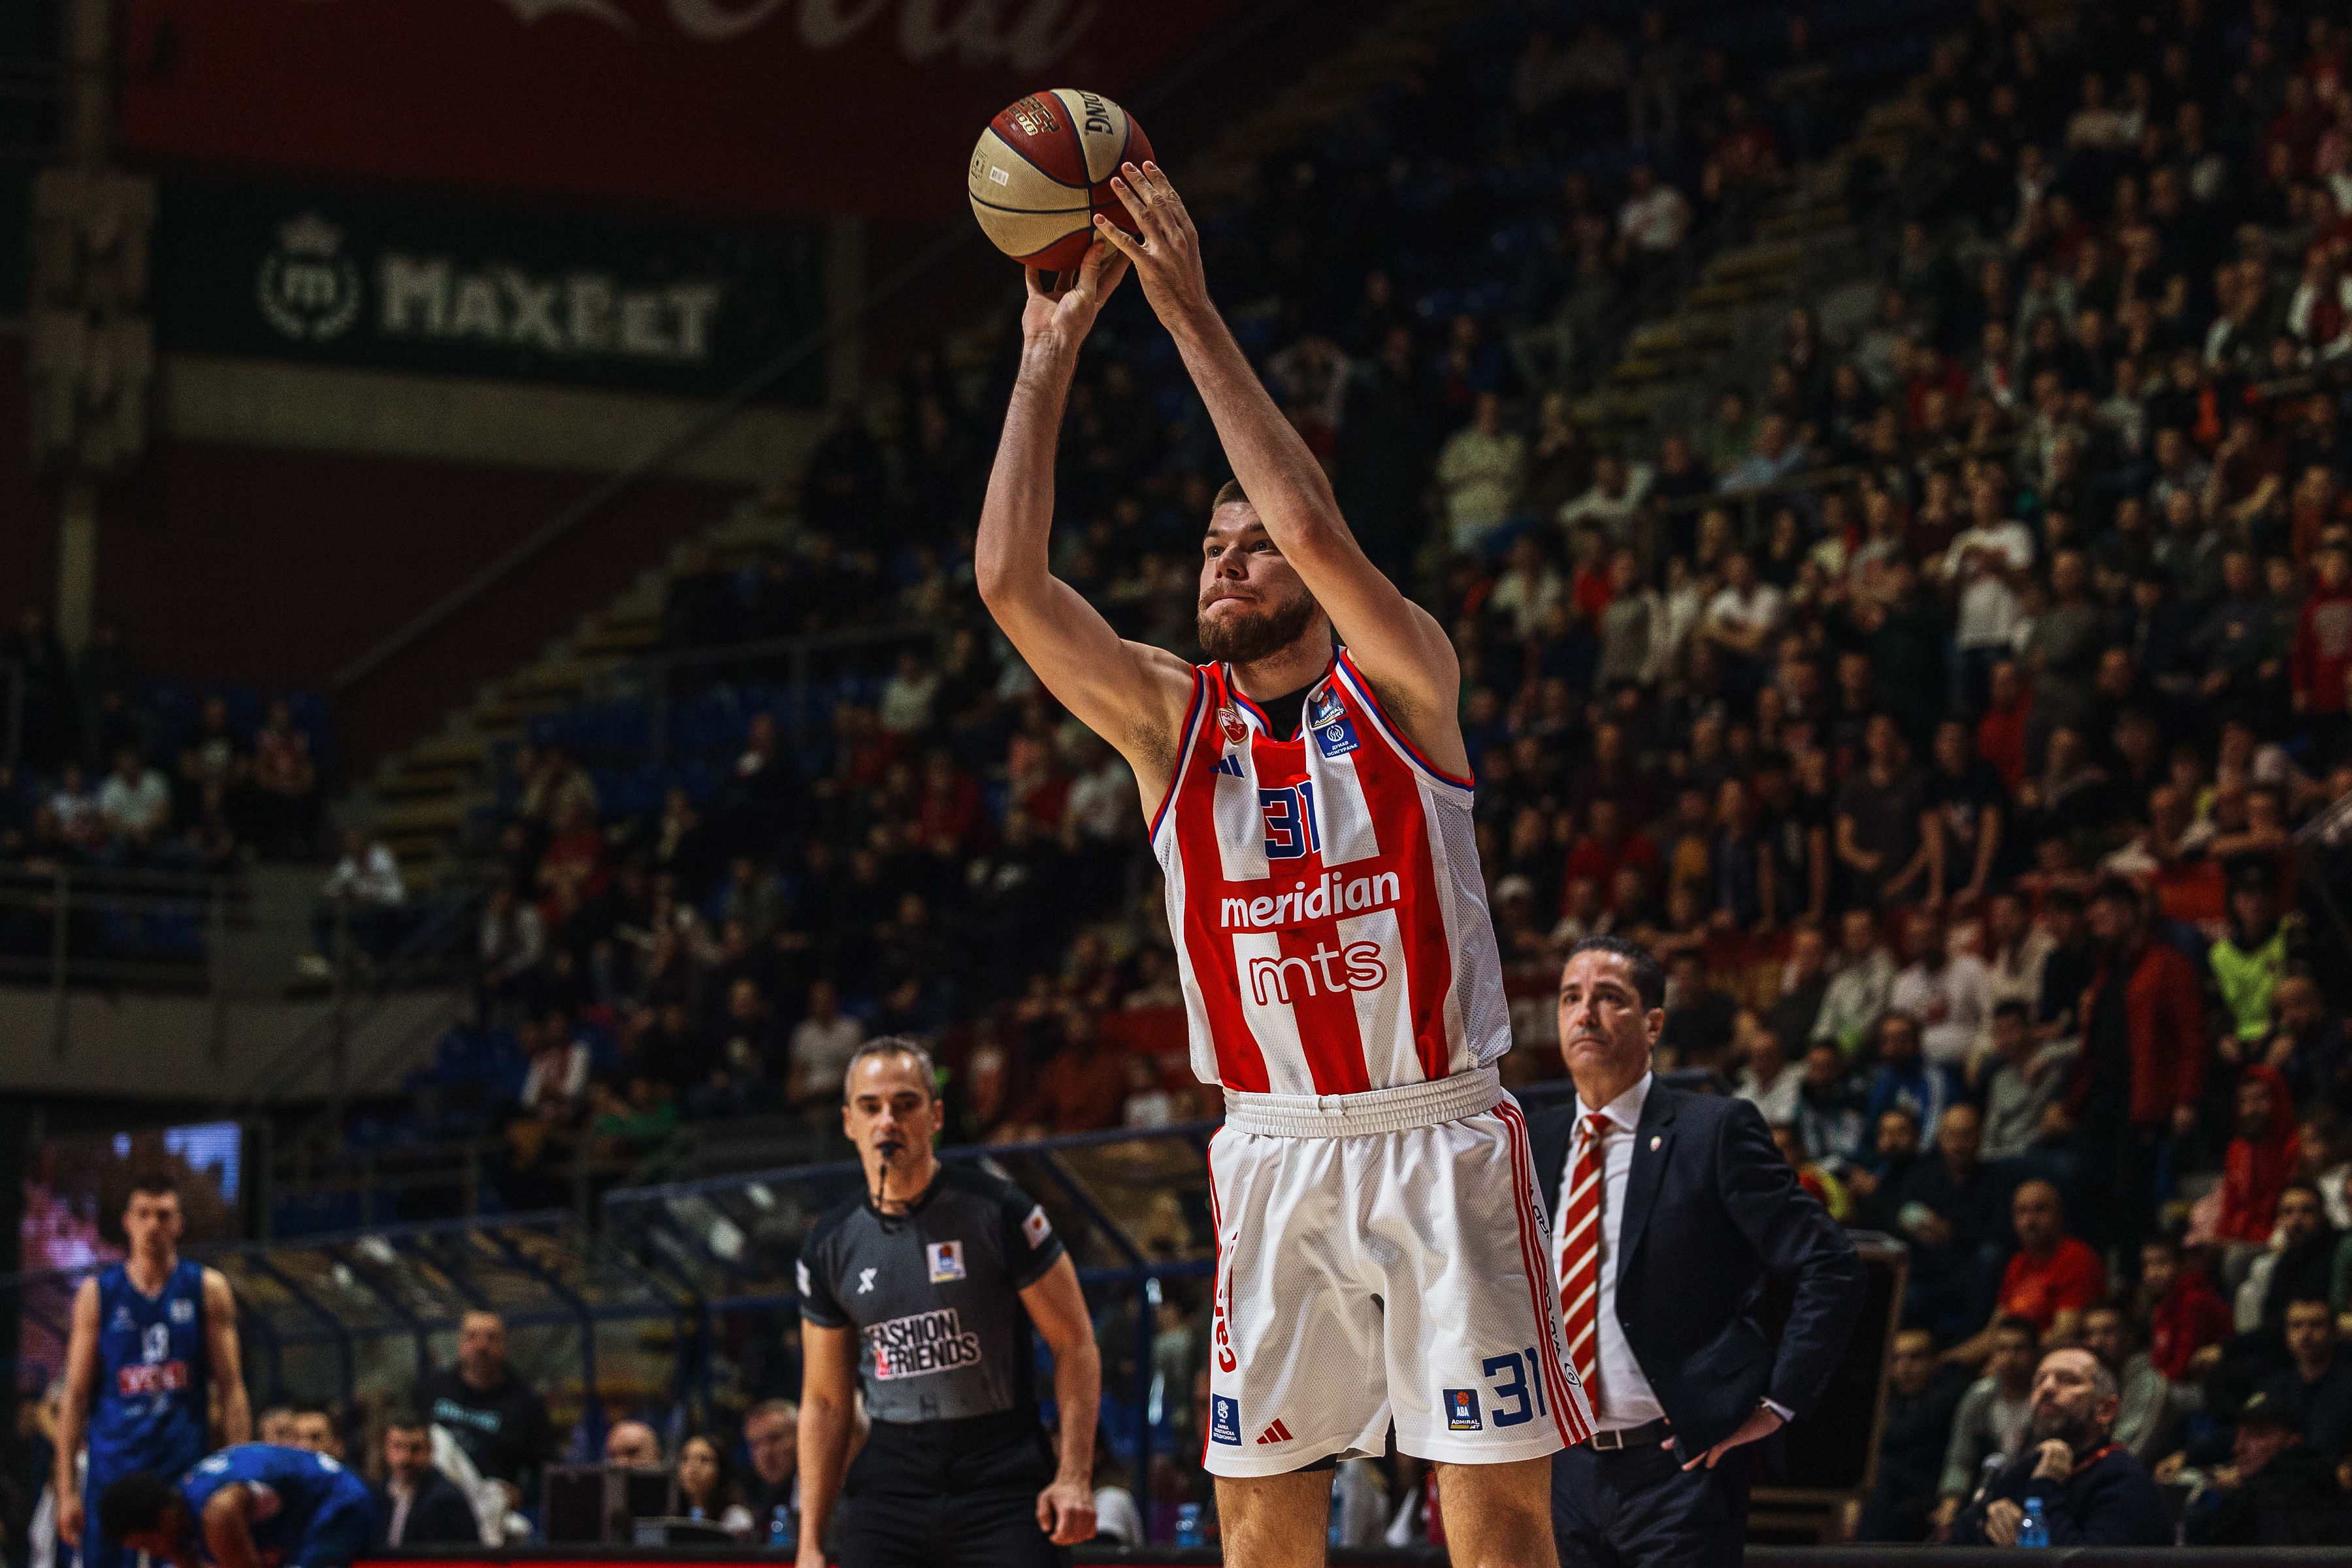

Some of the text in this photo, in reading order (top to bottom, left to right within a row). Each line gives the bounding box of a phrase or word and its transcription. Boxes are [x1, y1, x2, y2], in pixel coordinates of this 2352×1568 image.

[1315, 706, 1344, 725] ADMIRAL
[1332, 740, 1349, 750] ДУНАВ
[1258, 780, 1321, 859] 31
[1220, 871, 1401, 928] meridian
[1250, 941, 1386, 1004] mts
[889, 1337, 977, 1375] FRIENDS
[1456, 1406, 1469, 1416] ABA
[1481, 1347, 1546, 1428] 31
